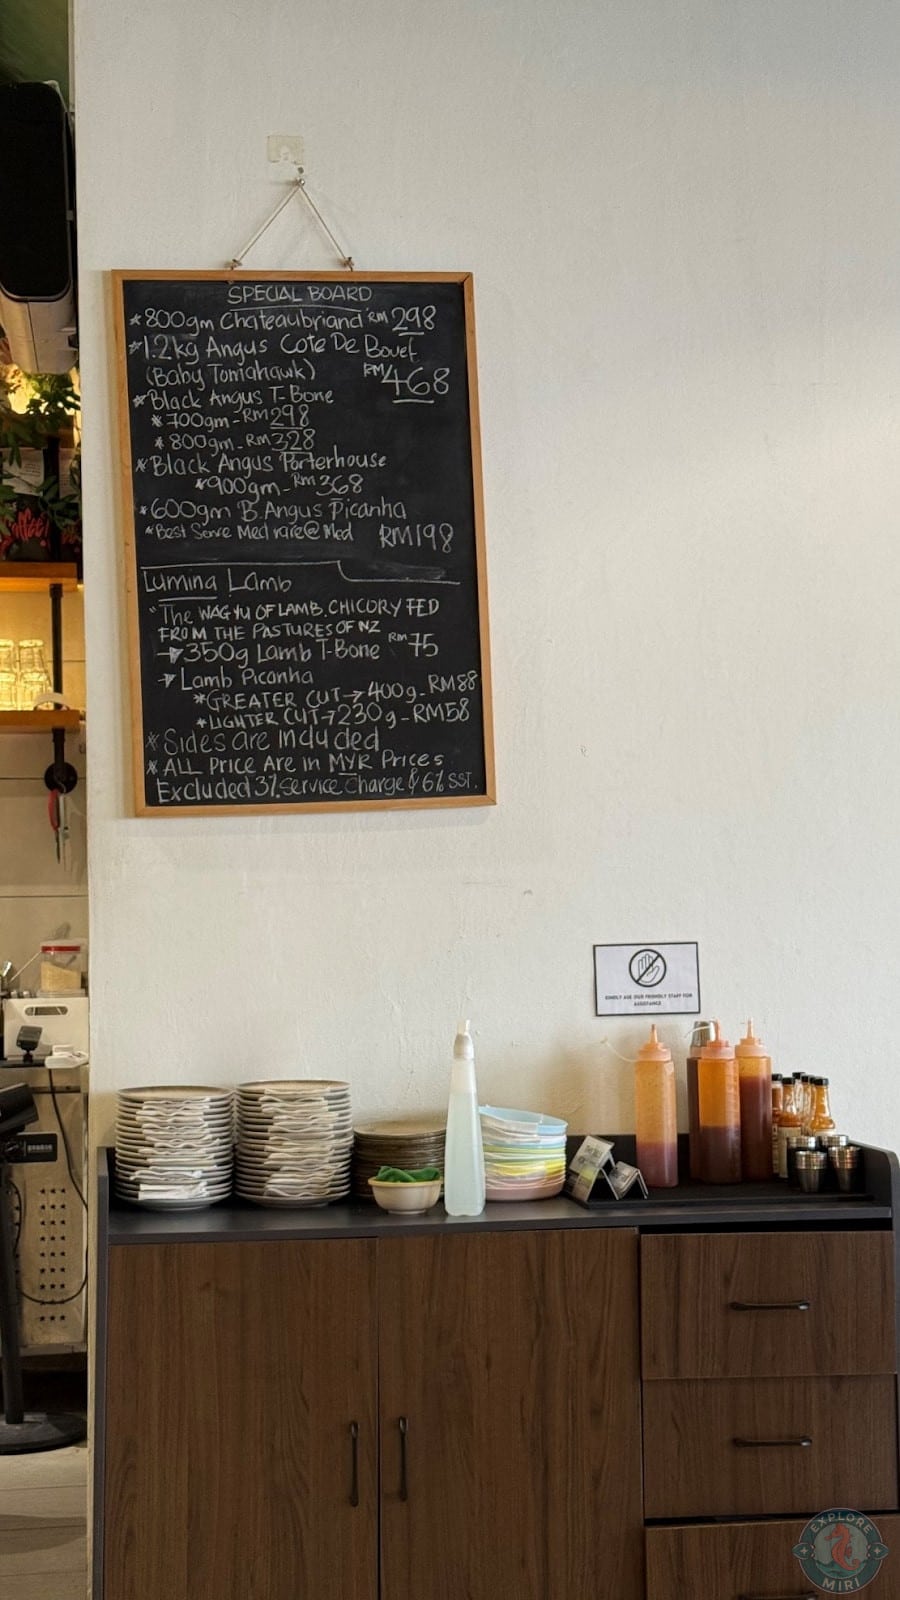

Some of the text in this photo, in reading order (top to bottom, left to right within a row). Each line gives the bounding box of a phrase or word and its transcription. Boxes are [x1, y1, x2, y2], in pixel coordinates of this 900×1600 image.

[227, 285, 372, 304] SPECIAL BOARD
[144, 307, 214, 336] 800gm
[220, 309, 363, 331] Chateaubriand
[143, 334, 199, 365] 1.2kg
[205, 335, 268, 366] Angus
[280, 333, 326, 354] Cote
[330, 332, 360, 353] De
[146, 363, 206, 391] (Baby
[207, 358, 316, 385] Tomahawk)
[147, 389, 202, 411] Black
[209, 389, 262, 413] Angus
[150, 445, 388, 479] Black Angus Porterhouse
[150, 498, 231, 526] 600gm
[264, 501, 323, 525] Angus
[328, 496, 407, 520] Picanha
[156, 523, 187, 540] Best
[237, 522, 269, 540] Med
[143, 568, 292, 593] Lumina Lamb
[255, 604, 275, 620] OF
[328, 598, 402, 617] CHICORY
[406, 598, 440, 617] FED
[158, 620, 381, 643] FROM THE PASTURES OF NZ
[183, 641, 249, 669] 350g
[257, 642, 312, 663] Lamb
[316, 638, 380, 660] T-Bone
[181, 666, 233, 690] Lamb
[206, 689, 297, 712] GREATER
[306, 687, 340, 708] CUT
[284, 707, 319, 726] CUT
[164, 728, 226, 755] Sides
[164, 758, 203, 776] ALL
[264, 755, 296, 772] Are
[329, 752, 373, 772] MYR
[157, 774, 250, 804] Excluded
[422, 770, 444, 793] 6%
